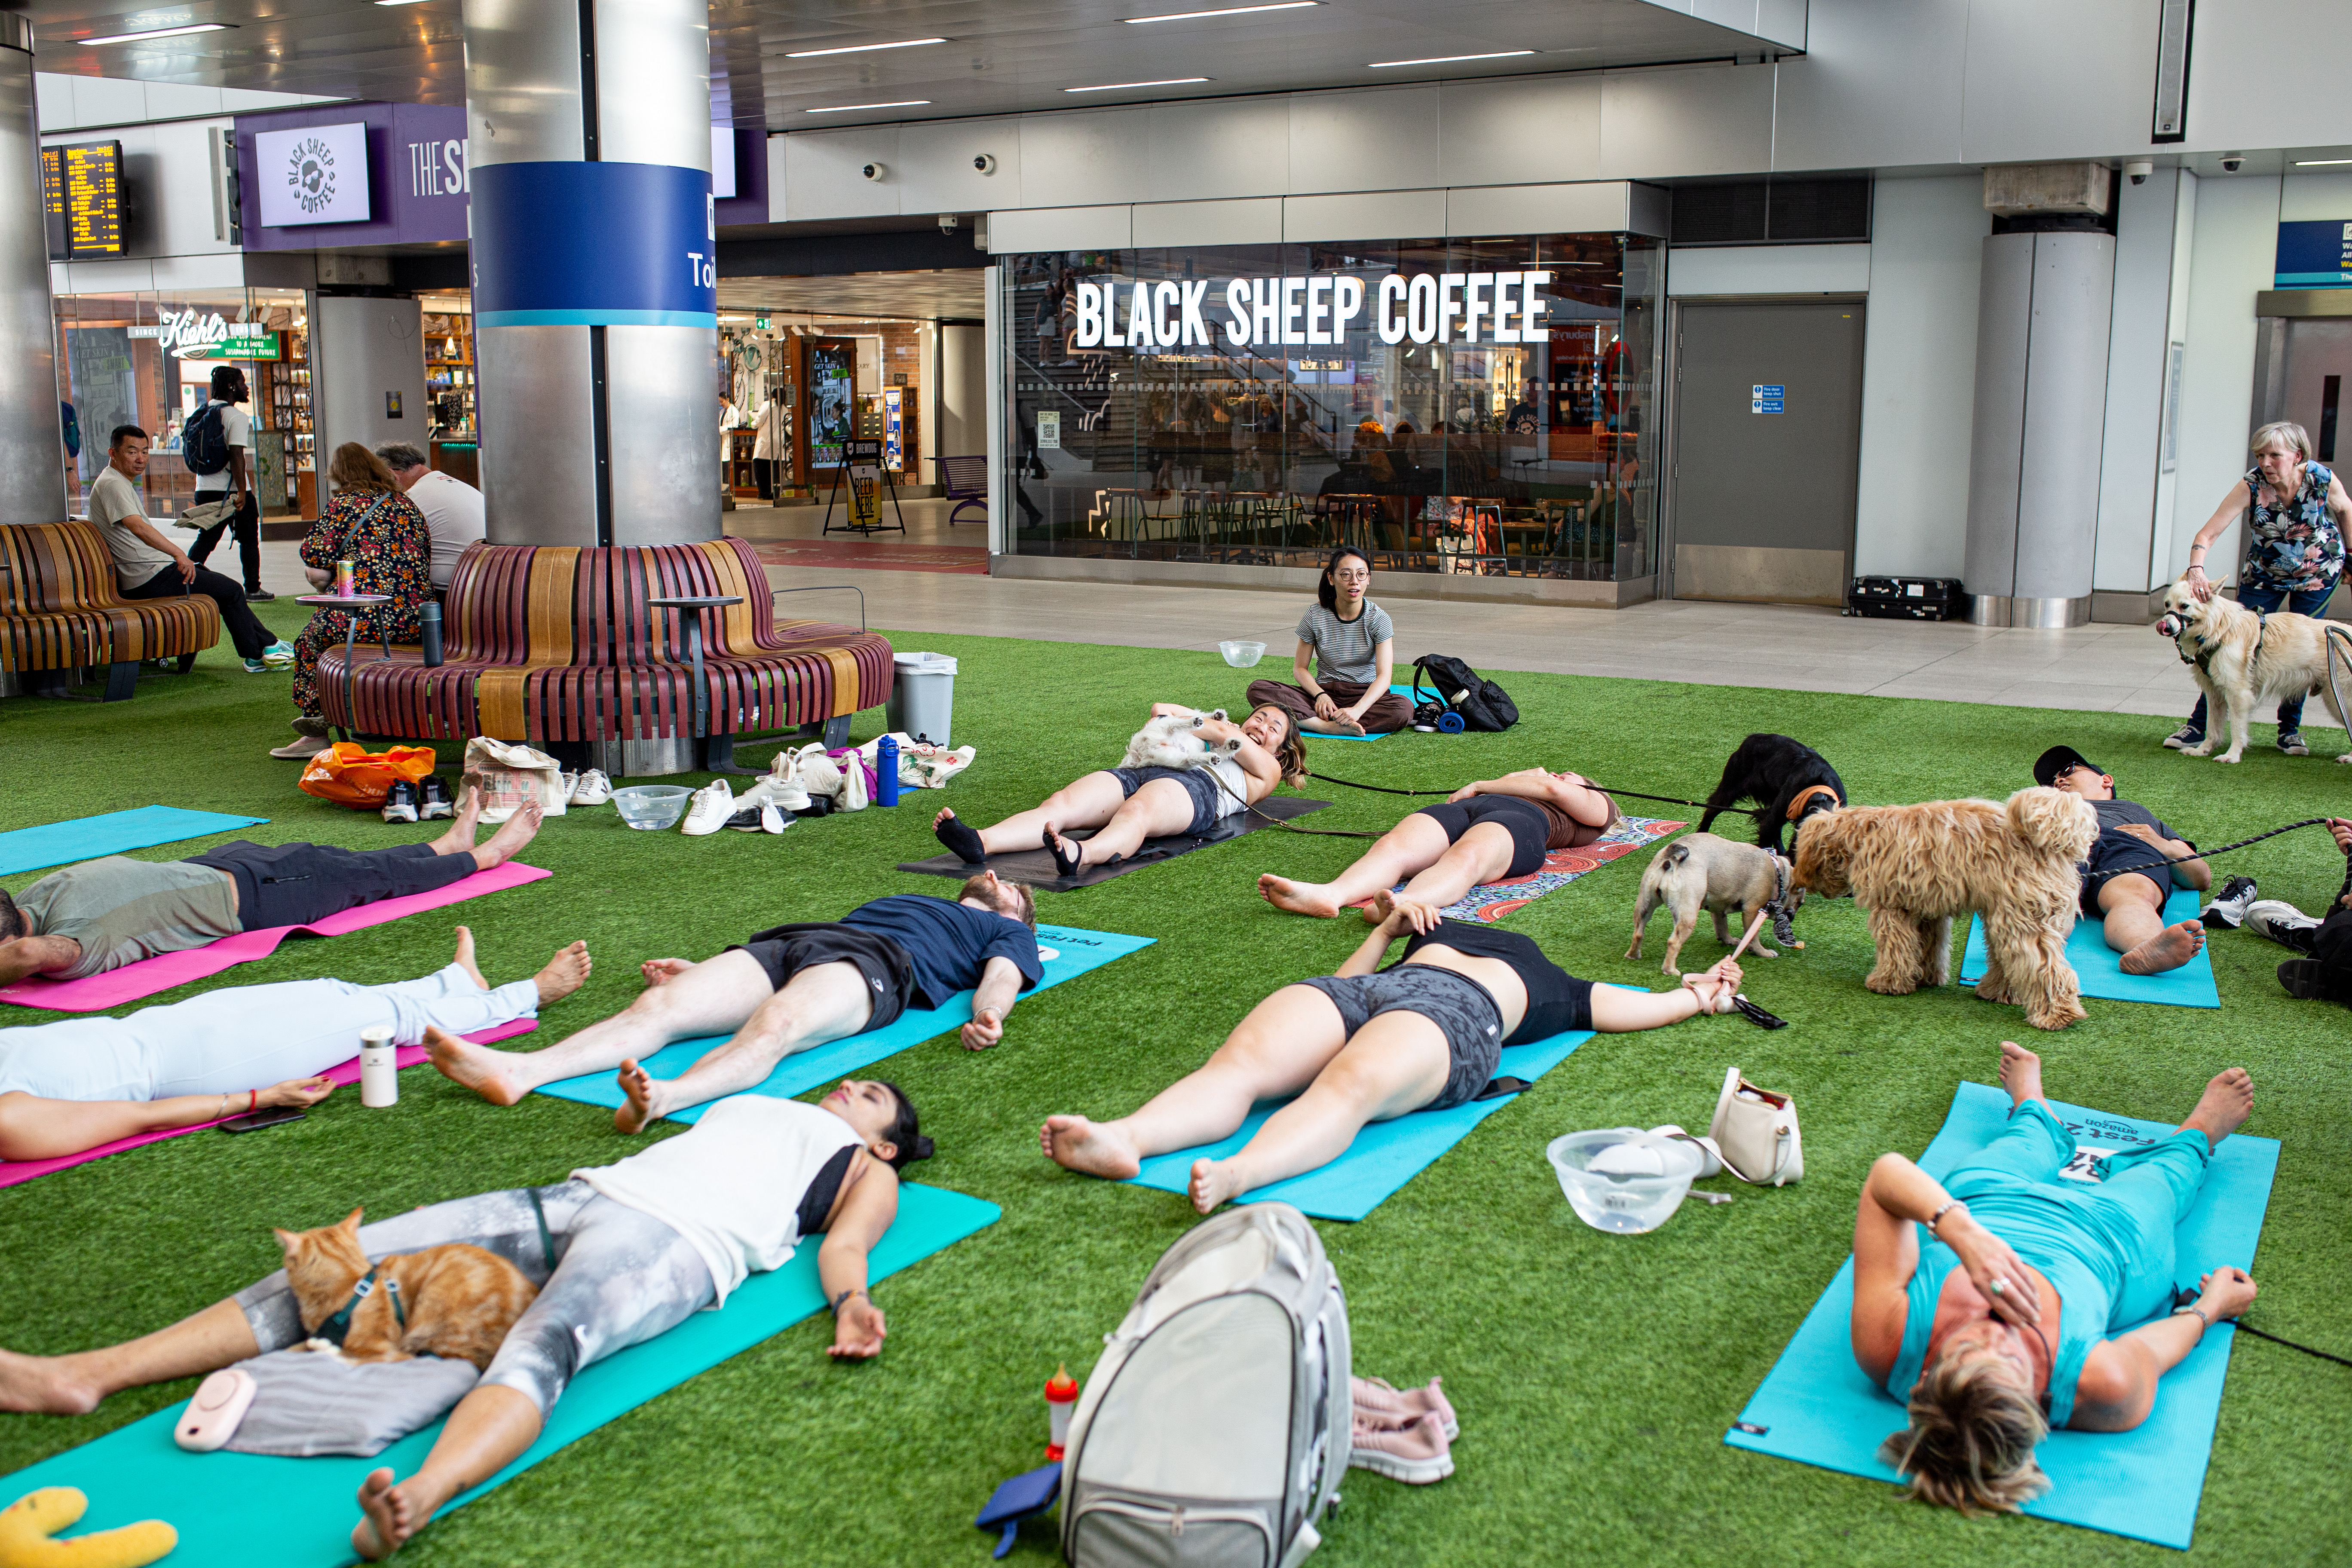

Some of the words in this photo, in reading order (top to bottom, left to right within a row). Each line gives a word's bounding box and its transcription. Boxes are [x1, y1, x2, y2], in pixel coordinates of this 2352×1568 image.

[288, 142, 306, 185] BLACK
[307, 138, 334, 166] SHEEP
[409, 141, 443, 196] THE
[444, 139, 470, 194] SI
[301, 182, 335, 213] COFFEE
[688, 252, 716, 289] Toil
[1077, 280, 1210, 347] BLACK
[1225, 276, 1361, 346] SHEEP
[1378, 270, 1550, 344] COFFEE
[135, 328, 157, 337] SINCE
[159, 309, 227, 348] Kiehl's
[856, 443, 877, 453] BREWDOG
[855, 477, 873, 495] BEER
[1067, 938, 1103, 946] Pet
[2086, 1118, 2138, 1135] amazon
[2089, 1127, 2156, 1146] Fest
